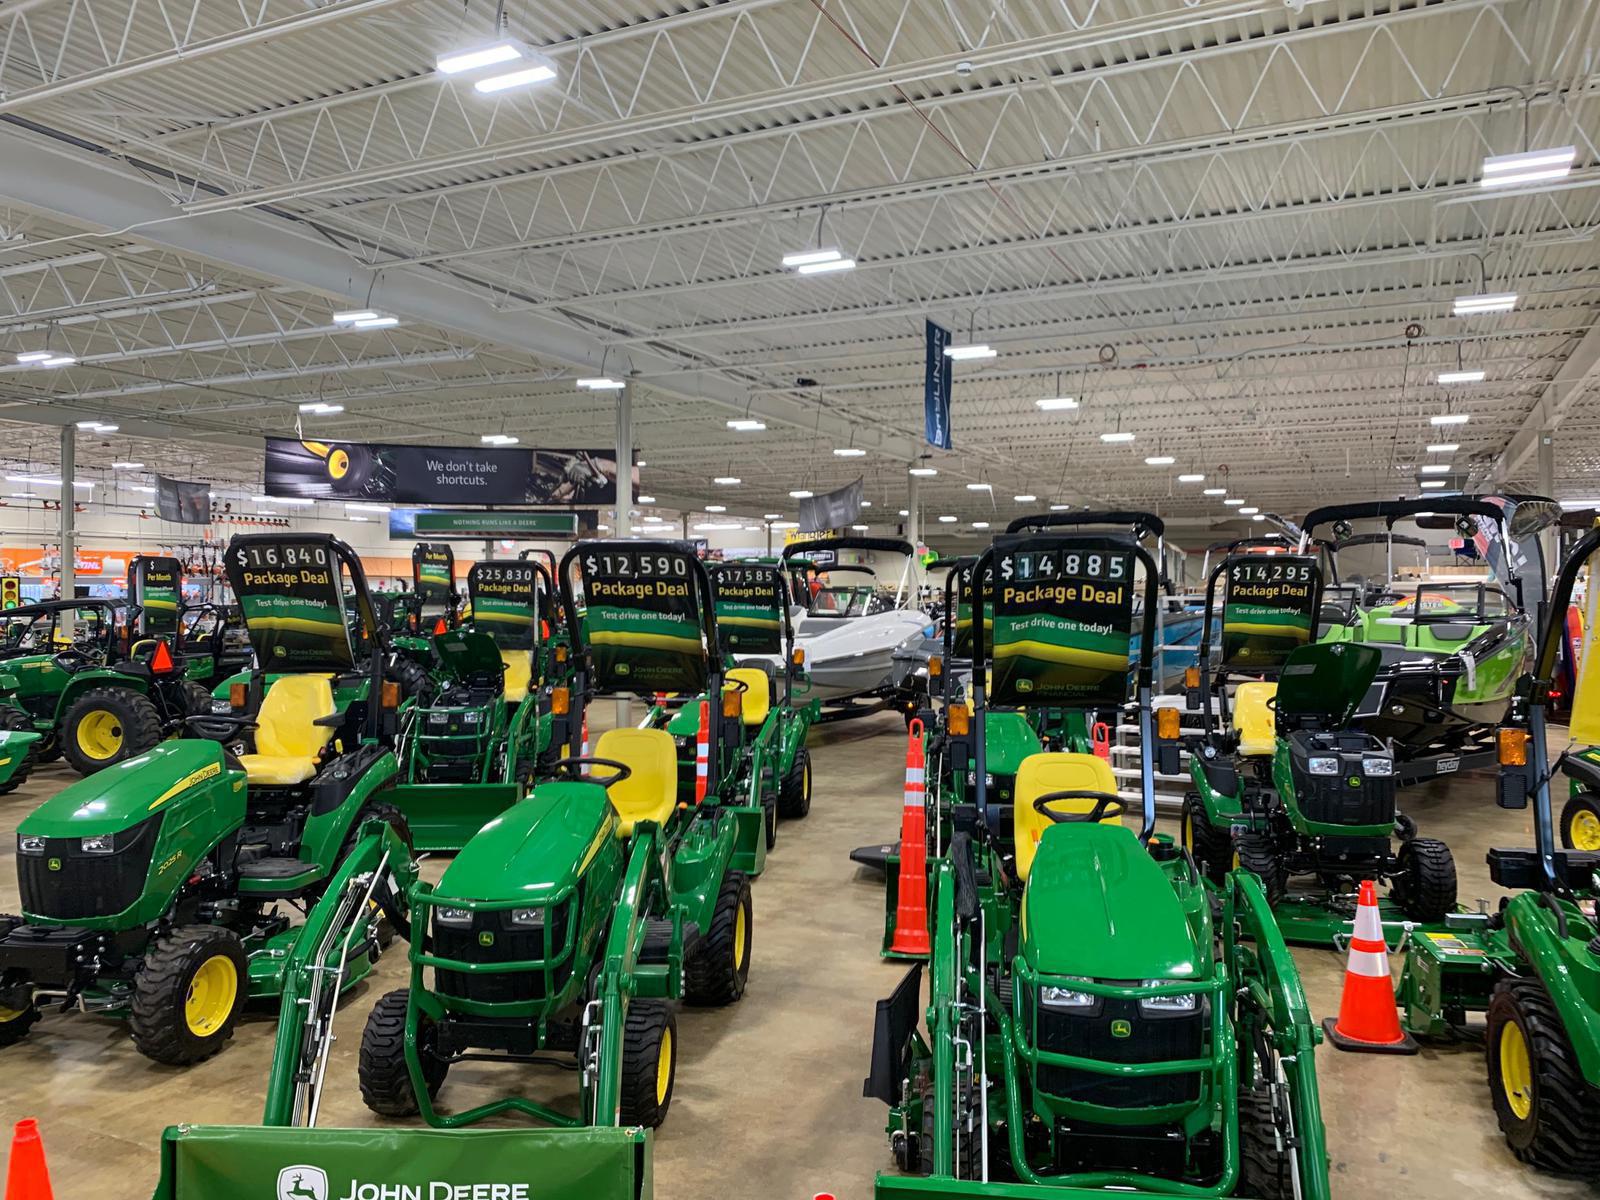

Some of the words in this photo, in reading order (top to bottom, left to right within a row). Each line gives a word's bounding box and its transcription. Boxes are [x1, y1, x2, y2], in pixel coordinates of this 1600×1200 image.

[426, 460, 443, 472] We
[446, 460, 473, 472] don't
[476, 461, 497, 473] take
[436, 473, 487, 486] shortcuts.
[452, 519, 480, 527] NOTHING
[482, 519, 498, 527] RUNS
[499, 519, 511, 527] LIKE
[518, 519, 537, 527] DEERE
[236, 548, 326, 569] $16,840
[586, 555, 686, 579] $12,590
[1001, 555, 1123, 580] $14,885
[243, 570, 298, 587] Package
[300, 570, 329, 584] Deal
[477, 568, 532, 583] $25,830
[717, 570, 773, 586] $17,585
[1232, 566, 1310, 584] $14,295
[478, 583, 512, 595] Package
[513, 583, 532, 593] Deal
[592, 581, 653, 599] Package
[656, 581, 689, 596] Deal
[718, 586, 754, 598] Package
[755, 586, 774, 597] Deal
[1004, 585, 1077, 604] Package
[1081, 585, 1122, 605] Deal
[1233, 585, 1279, 599] Package
[1282, 584, 1308, 597] Deal
[256, 599, 272, 607] Test
[273, 598, 290, 607] drive
[305, 599, 328, 609] today!
[1280, 606, 1301, 616] today!
[601, 611, 618, 620] Test
[618, 611, 640, 620] drive
[641, 612, 656, 620] one
[659, 612, 686, 623] today!
[1010, 621, 1029, 631] Test
[1031, 618, 1056, 629] drive
[1057, 621, 1077, 631] one
[1079, 622, 1113, 635] today!
[340, 1179, 421, 1200] JOHN
[429, 1181, 529, 1200] DEERE
